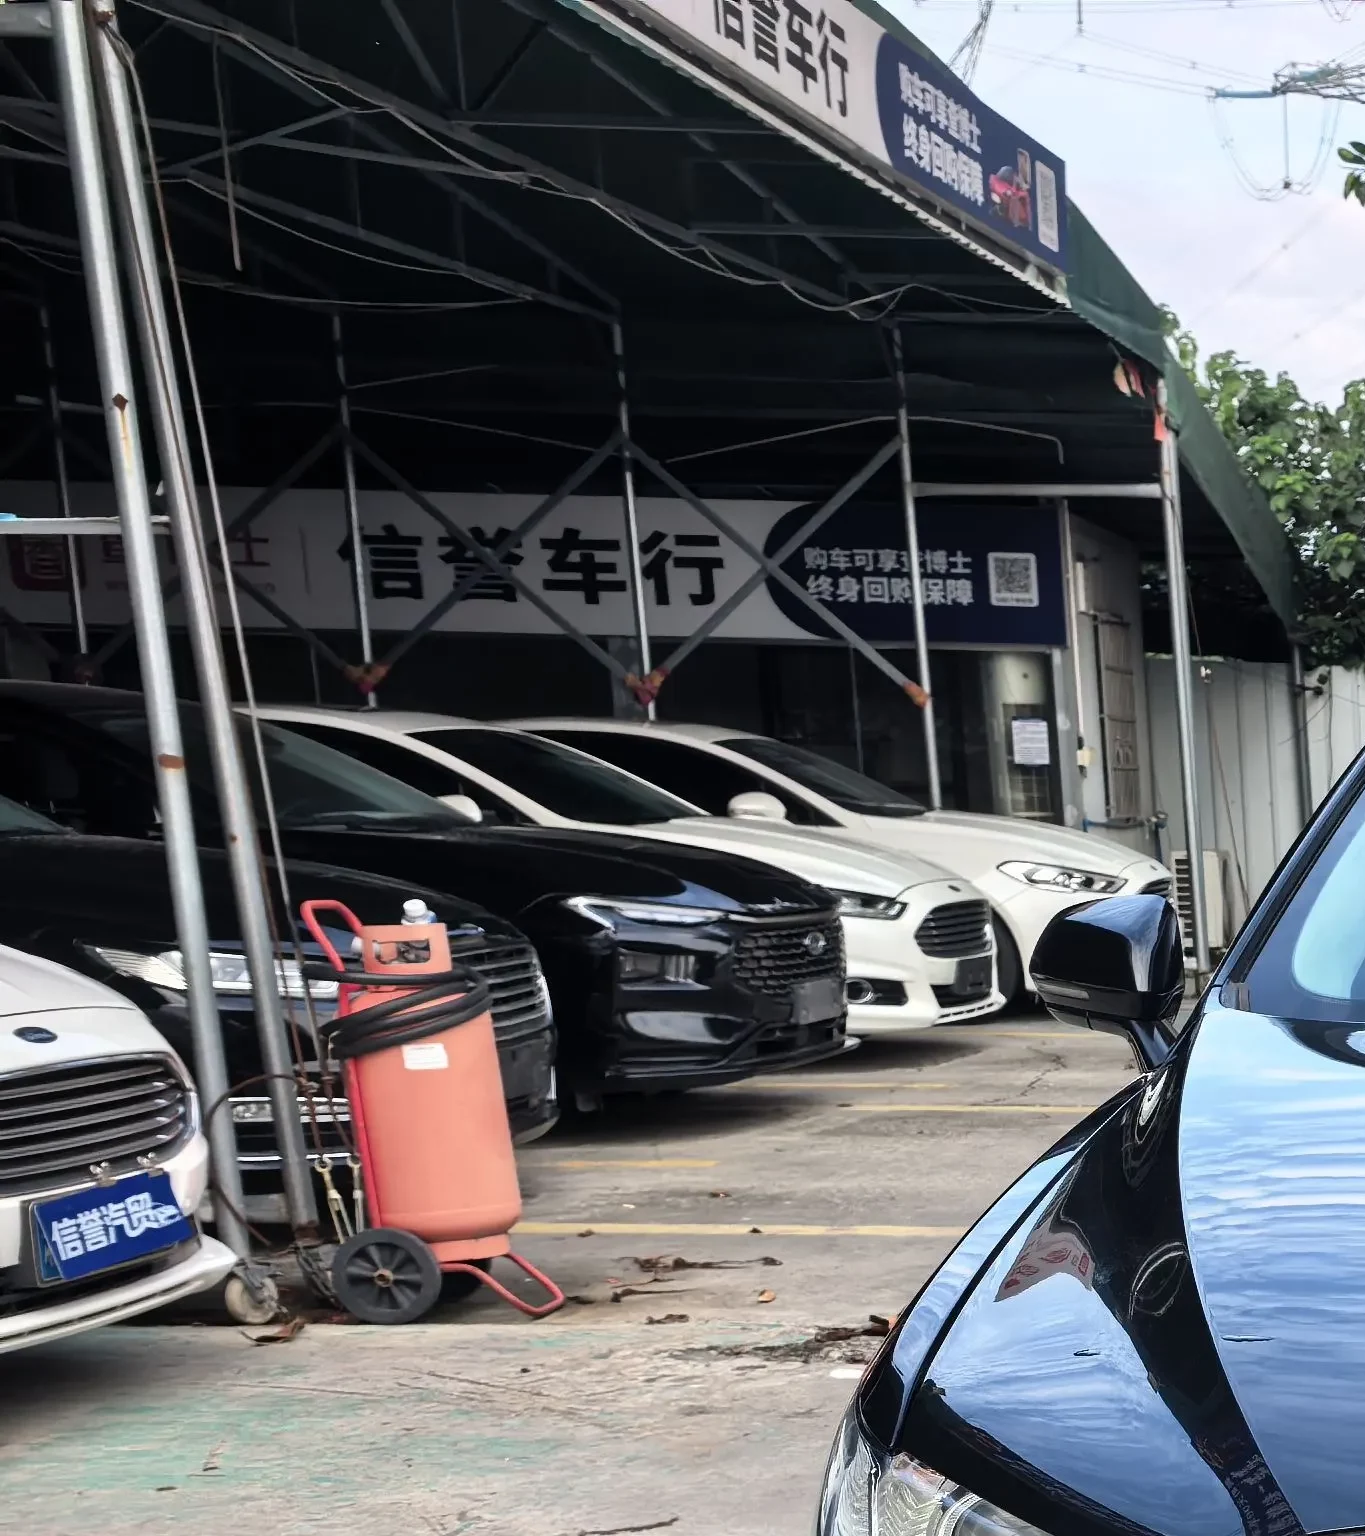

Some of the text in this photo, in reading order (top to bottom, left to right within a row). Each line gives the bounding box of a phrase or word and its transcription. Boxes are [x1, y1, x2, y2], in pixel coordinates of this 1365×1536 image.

[337, 523, 724, 606] 信誉车行
[51, 1191, 158, 1261] 信誉汽贸
